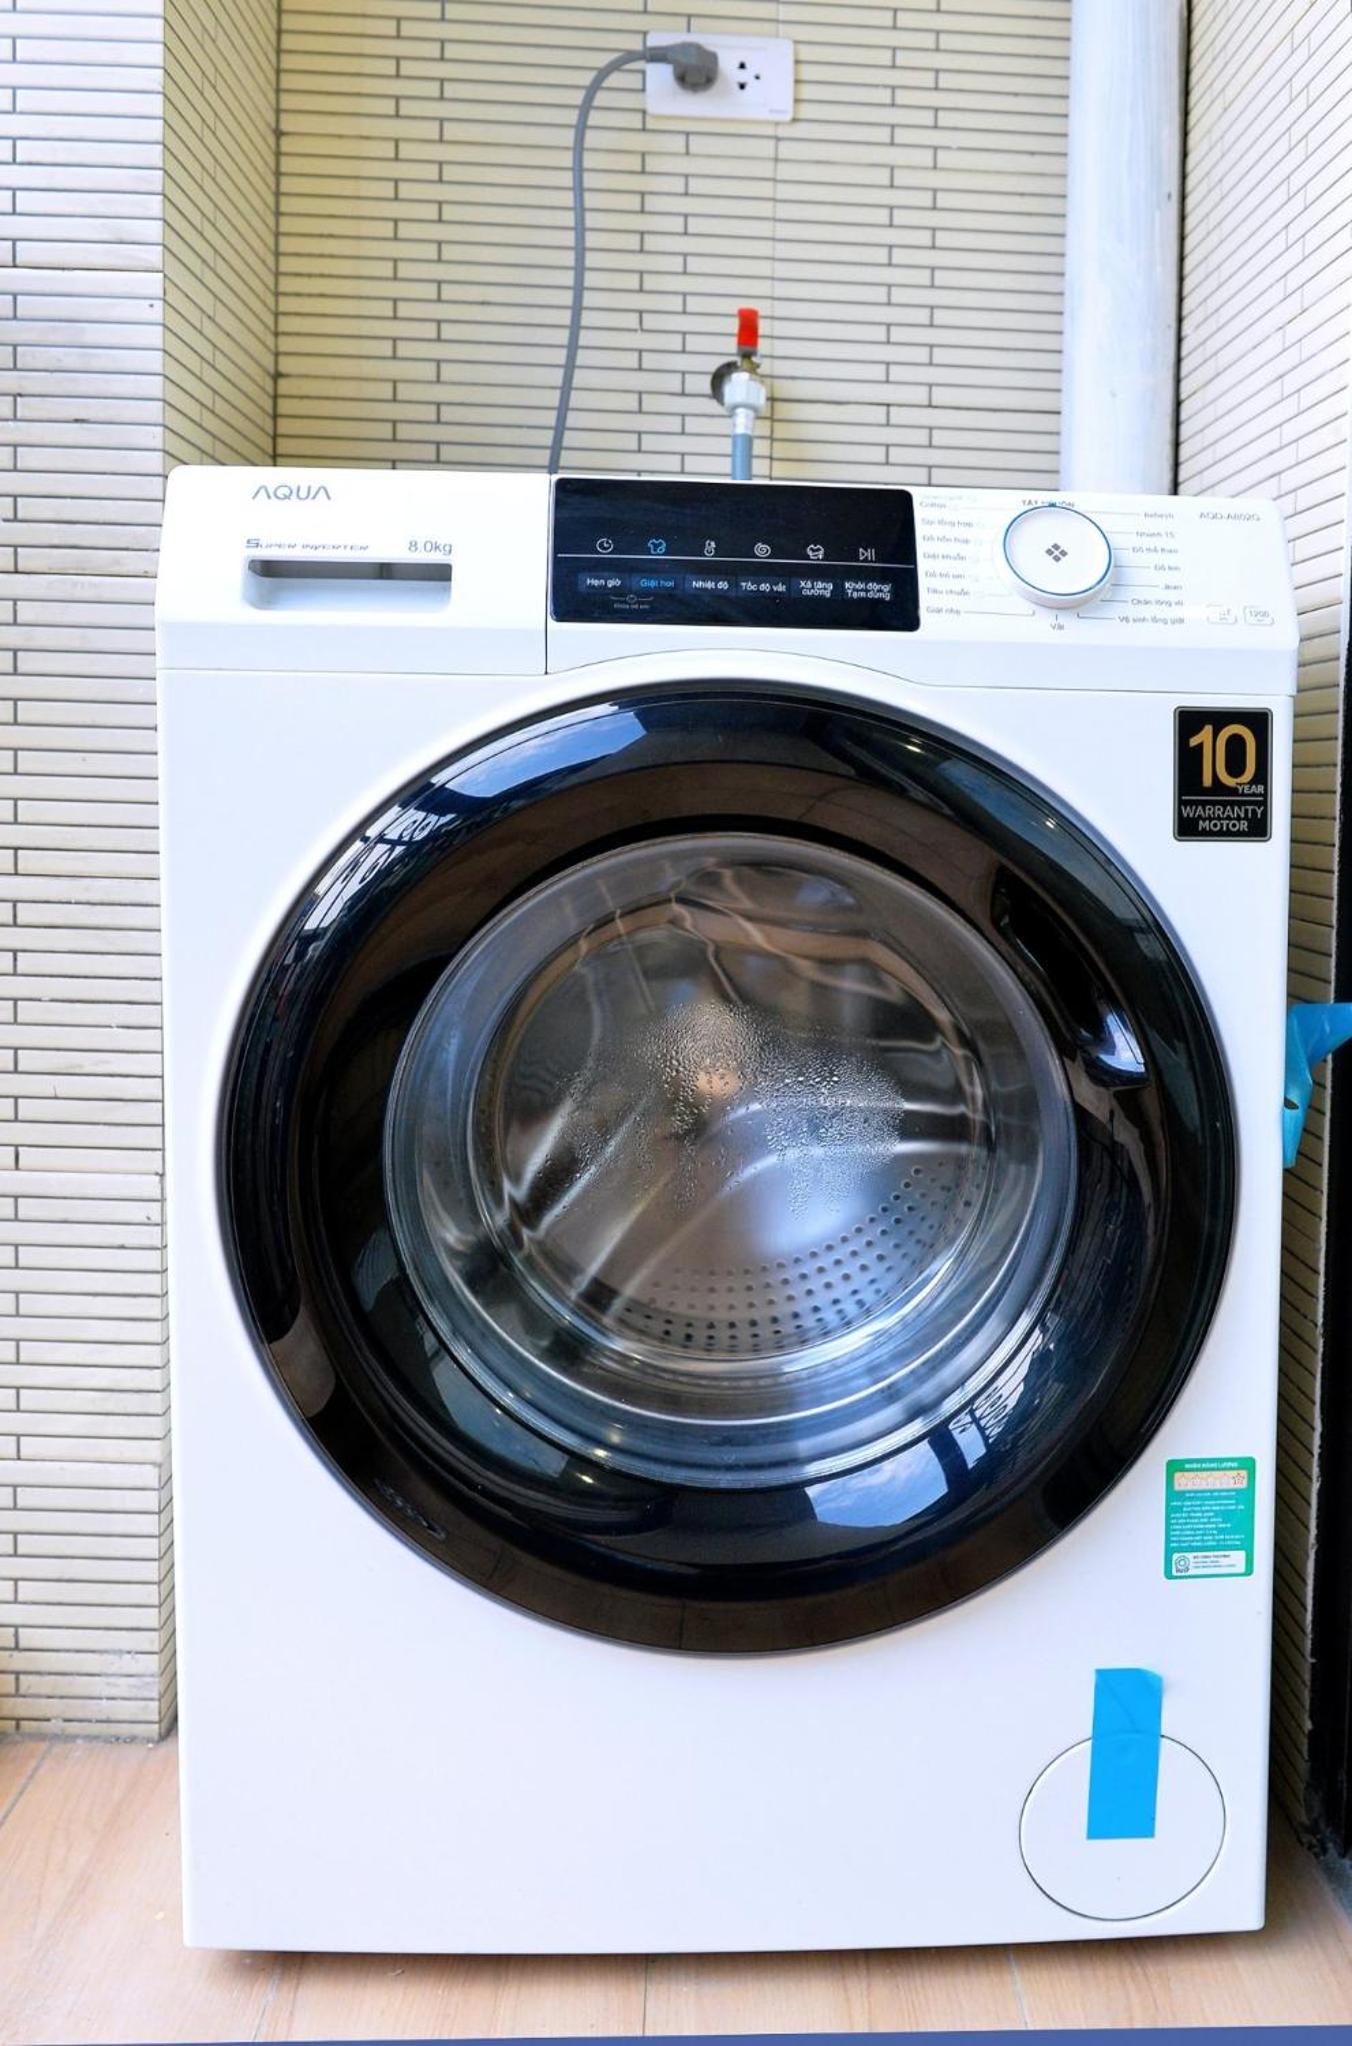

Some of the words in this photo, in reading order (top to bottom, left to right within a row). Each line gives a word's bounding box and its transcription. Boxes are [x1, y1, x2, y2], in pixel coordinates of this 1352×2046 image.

[252, 485, 332, 501] AQUA
[408, 540, 453, 555] 8.0kg
[586, 578, 605, 588] Hẹn
[607, 578, 622, 588] giờ
[692, 579, 716, 590] Nhiệt
[717, 580, 730, 591] độ
[740, 581, 758, 592] Tốc
[759, 582, 771, 592] độ
[772, 582, 786, 592] vắt
[813, 580, 833, 590] tăng
[801, 588, 831, 598] cường
[847, 589, 867, 599] Tạm
[1189, 723, 1256, 788] 10
[1236, 784, 1264, 795] YEAR
[1181, 805, 1265, 819] WARRANTY
[1198, 820, 1249, 832] MOTOR
